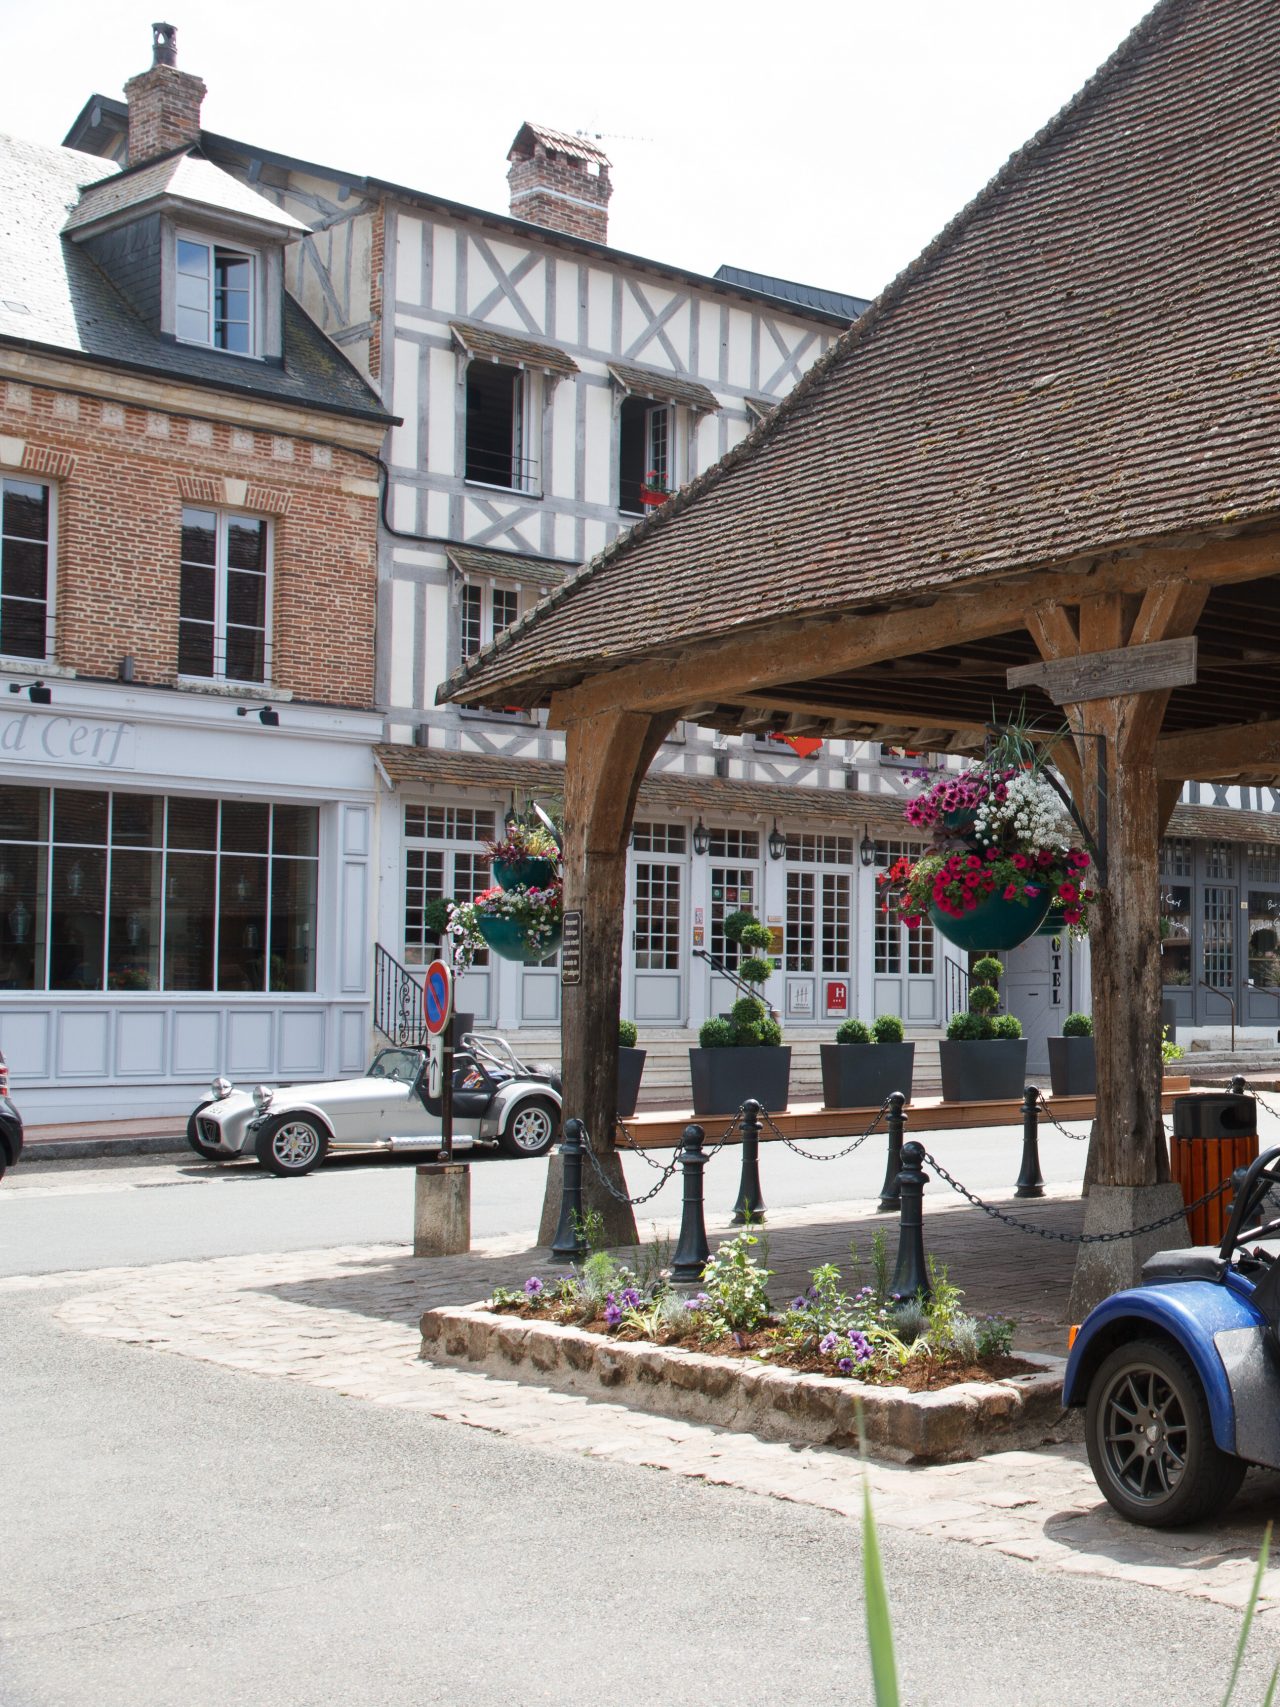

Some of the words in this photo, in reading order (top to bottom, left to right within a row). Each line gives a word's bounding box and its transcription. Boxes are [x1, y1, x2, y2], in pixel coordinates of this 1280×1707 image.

[41, 715, 136, 766] Cerf
[836, 987, 845, 998] H
[1051, 936, 1062, 1005] OTEL
